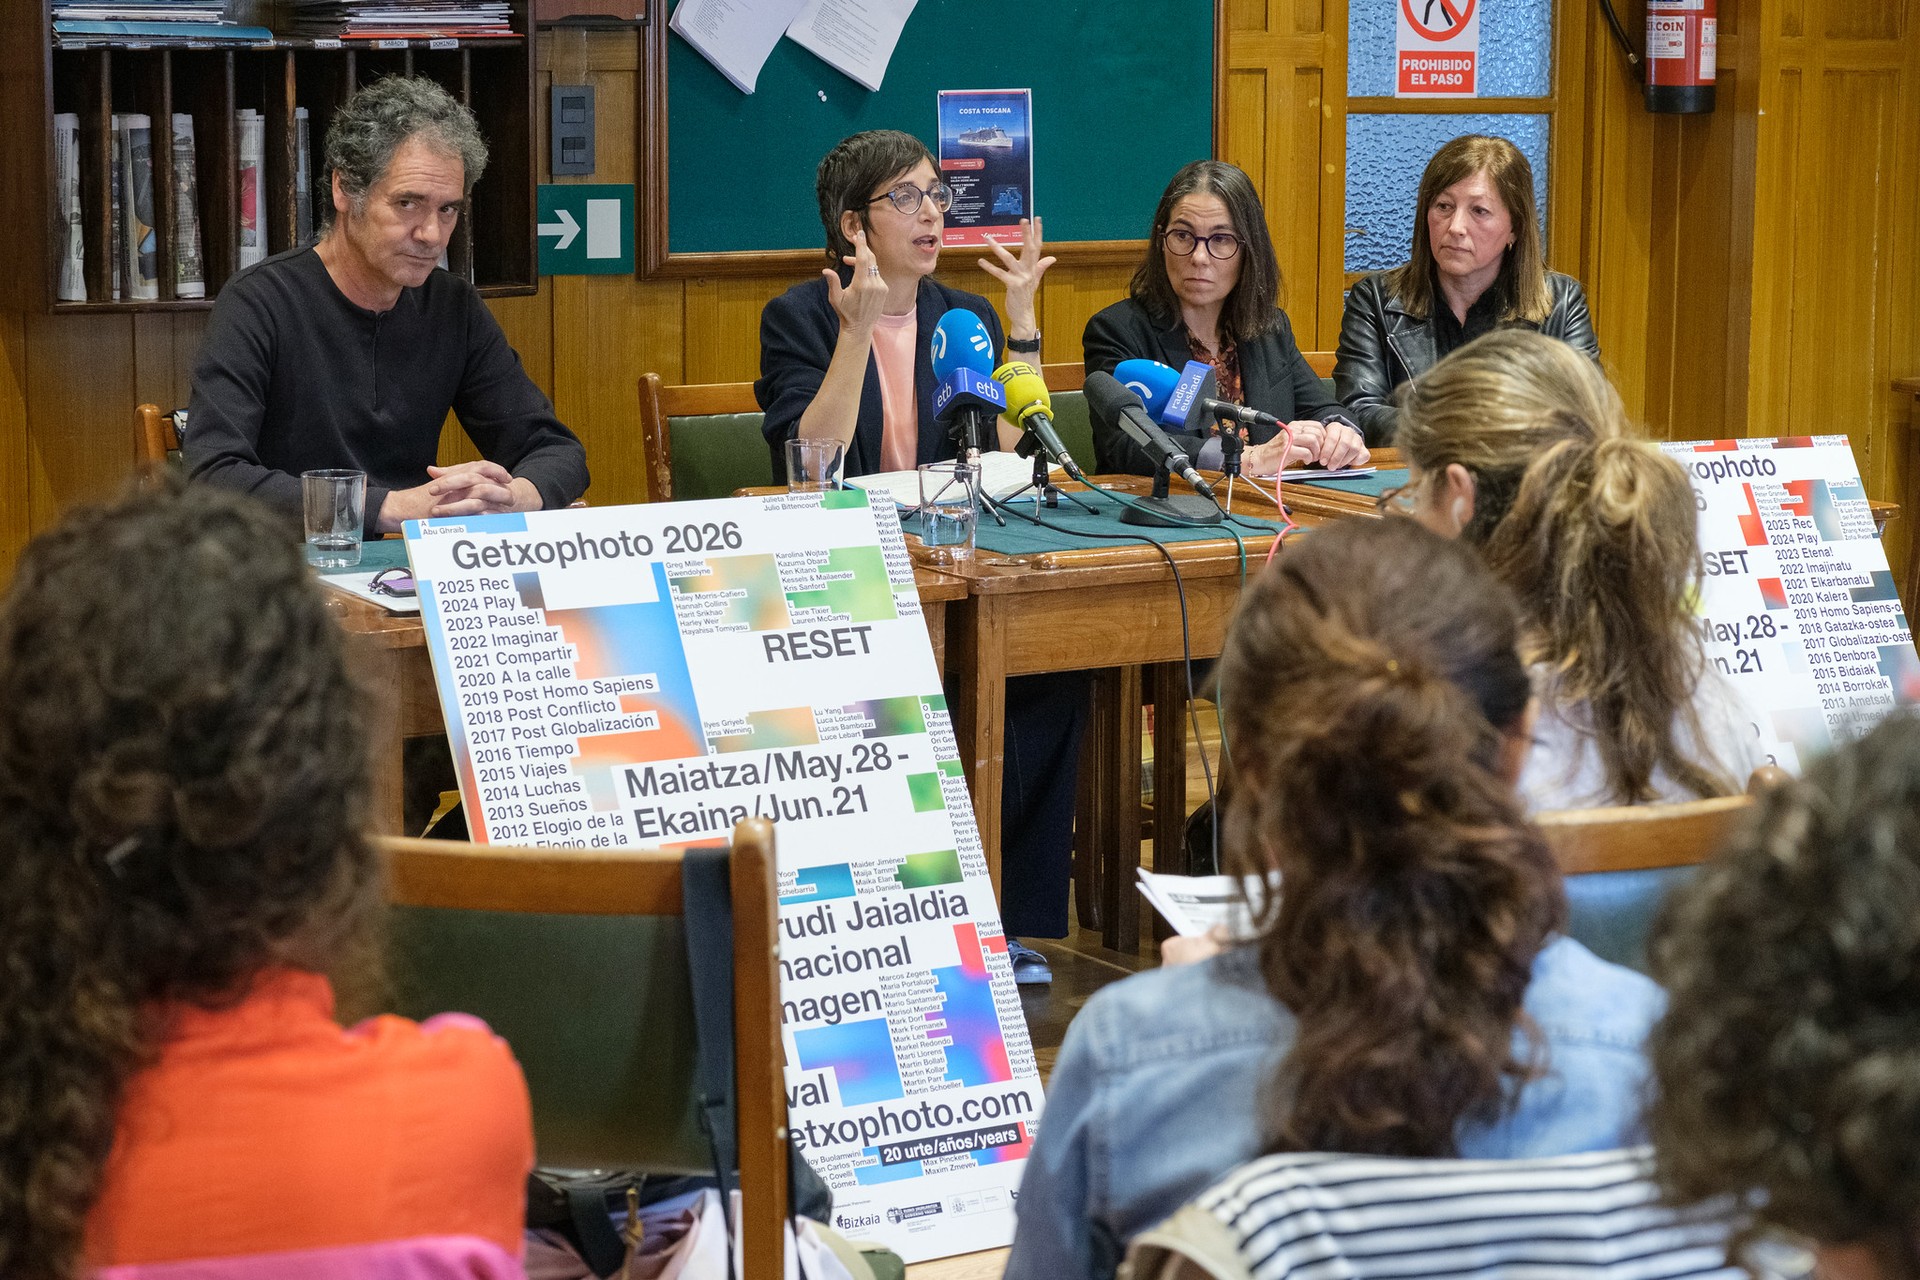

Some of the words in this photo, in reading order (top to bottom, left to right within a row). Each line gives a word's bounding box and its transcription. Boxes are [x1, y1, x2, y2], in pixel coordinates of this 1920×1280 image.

[432, 39, 458, 48] DOMINGO
[1402, 58, 1472, 72] PROHIBIDO
[1411, 73, 1427, 85] EL
[1438, 73, 1463, 85] PASO
[959, 107, 981, 115] COSTA
[937, 382, 952, 408] etb
[976, 381, 999, 400] etb
[1171, 383, 1188, 410] radio
[1180, 374, 1202, 412] euskadi
[422, 527, 439, 536] Abu
[438, 525, 465, 535] Ghraib
[1765, 519, 1790, 530] 2025
[1792, 518, 1812, 528] Rec
[452, 530, 653, 569] Getxophoto
[663, 521, 742, 554] 2026
[1770, 534, 1794, 545] 2024
[1796, 533, 1818, 545] Play
[1775, 548, 1799, 560] 2023
[1801, 546, 1833, 558] Etena!
[778, 568, 794, 576] Ken
[793, 566, 818, 575] Kitano
[1779, 563, 1805, 575] 2022
[1805, 561, 1851, 574] Imajinatu
[438, 579, 474, 594] 2025
[479, 577, 509, 591] Rec
[782, 584, 799, 592] Kris
[797, 581, 827, 591] Sanford
[1784, 578, 1808, 589] 2021
[1810, 574, 1869, 587] Elkarbanatu
[442, 597, 478, 613] 2024
[483, 595, 515, 611] Play
[1789, 592, 1813, 604] 2020
[1815, 591, 1848, 602] Kalera
[788, 609, 810, 617] Laure
[809, 607, 830, 615] Tixier
[1793, 607, 1817, 619] 2019
[1819, 606, 1850, 617] Homo
[446, 616, 483, 631] 2023
[487, 611, 540, 627] Pause!
[1798, 622, 1822, 634] 2018
[1824, 619, 1895, 632] Gatazka-ostea
[450, 634, 487, 650] 2022
[491, 630, 558, 647] Imaginar
[762, 625, 872, 663] RESET
[1803, 637, 1825, 649] 2017
[454, 653, 489, 669] 2021
[496, 646, 572, 665] Compartir
[1807, 652, 1831, 664] 2016
[1833, 650, 1876, 662] Denbora
[458, 672, 495, 687] 2020
[502, 670, 513, 684] A
[516, 669, 531, 682] la
[535, 665, 570, 680] calle
[1812, 667, 1836, 679] 2015
[1838, 664, 1876, 677] Bidaiak
[462, 690, 498, 706] 2019
[503, 687, 539, 702] Post
[542, 685, 588, 698] Homo
[592, 678, 653, 695] Sapiens
[1817, 682, 1840, 694] 2014
[1842, 678, 1889, 692] Borrokak
[1821, 697, 1846, 709] 2013
[1848, 693, 1894, 708] Ametsak
[467, 709, 503, 725] 2018
[507, 706, 543, 721] Post
[547, 700, 616, 717] Conflicto
[813, 708, 824, 717] Lu
[823, 707, 843, 716] Yang
[814, 716, 834, 725] Luca
[833, 712, 864, 723] Locatelli
[471, 728, 505, 744] 2017
[511, 725, 547, 740] Post
[551, 714, 654, 736] Globalización
[817, 725, 840, 733] Lucas
[839, 721, 874, 731] Bambozzi
[819, 733, 838, 742] Luce
[837, 730, 862, 740] Lebart
[475, 747, 511, 763] 2016
[515, 743, 573, 759] Tiempo
[479, 766, 515, 782] 2015
[519, 762, 567, 779] Viajes
[483, 785, 519, 801] 2014
[524, 781, 581, 797] Luchas
[488, 804, 524, 820] 2013
[528, 799, 587, 816] Sueños
[634, 784, 869, 840] Ekaina/Jun.21
[492, 823, 528, 840] 2012
[532, 818, 582, 836] Elogio
[587, 815, 606, 829] de
[610, 813, 623, 826] la
[591, 835, 610, 848] de
[614, 832, 628, 845] la
[854, 877, 877, 886] Maika
[876, 875, 894, 884] Elan
[856, 886, 875, 895] Maja
[874, 882, 902, 893] Daniels
[846, 889, 969, 931] Jaialdia
[877, 973, 905, 983] Marcos
[905, 969, 930, 979] Zegers
[887, 1016, 907, 1026] Mark
[906, 1013, 924, 1024] Dorf
[891, 1034, 912, 1044] Mark
[911, 1033, 926, 1041] Lee
[898, 1060, 923, 1070] Martin
[922, 1056, 946, 1067] Bollati
[900, 1069, 925, 1079] Martin
[924, 1065, 946, 1075] Kollar
[902, 1078, 927, 1088] Martin
[926, 1075, 942, 1084] Parr
[883, 1146, 903, 1164] 20
[903, 1126, 1018, 1160] urte/años/years
[829, 1171, 853, 1181] Covelli
[831, 1179, 857, 1190] Gómez
[844, 1213, 881, 1230] Bizkaia
